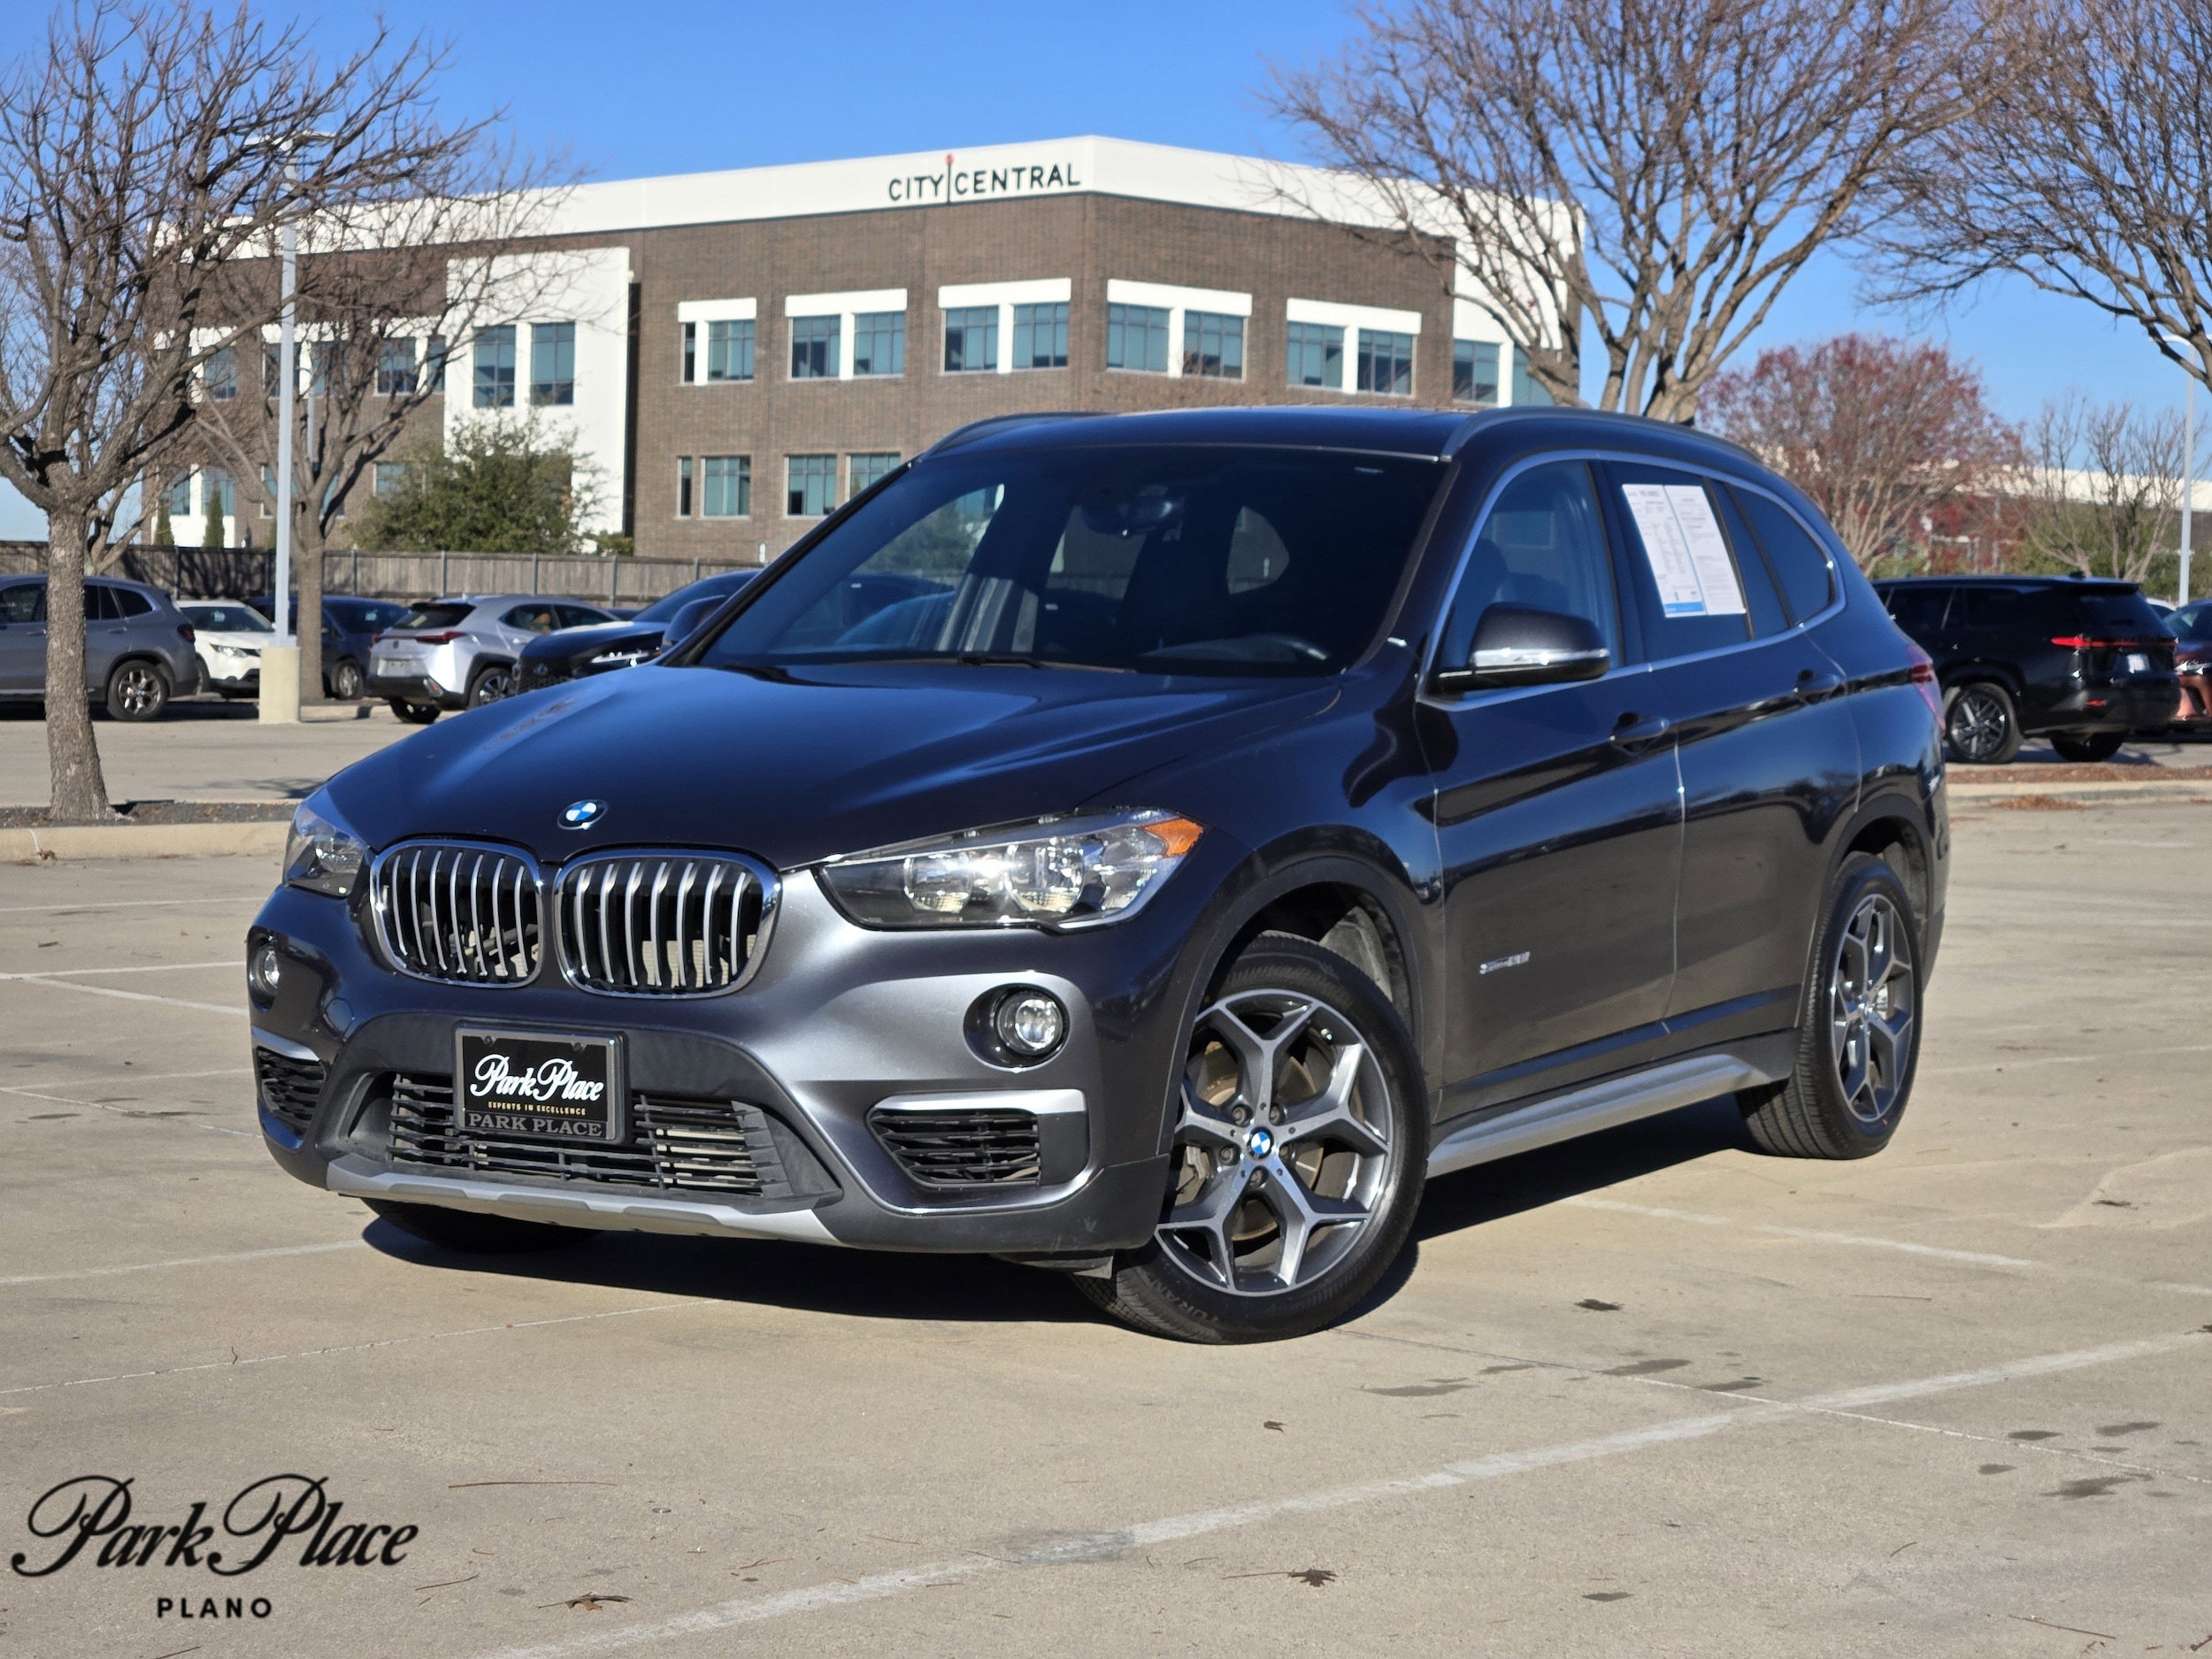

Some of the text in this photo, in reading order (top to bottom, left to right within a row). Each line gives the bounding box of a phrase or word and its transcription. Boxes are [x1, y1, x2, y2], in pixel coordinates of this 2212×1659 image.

[888, 163, 1081, 201] CITY CENTRAL
[470, 1054, 604, 1101] Park Place
[469, 1114, 602, 1136] PARK PLACE
